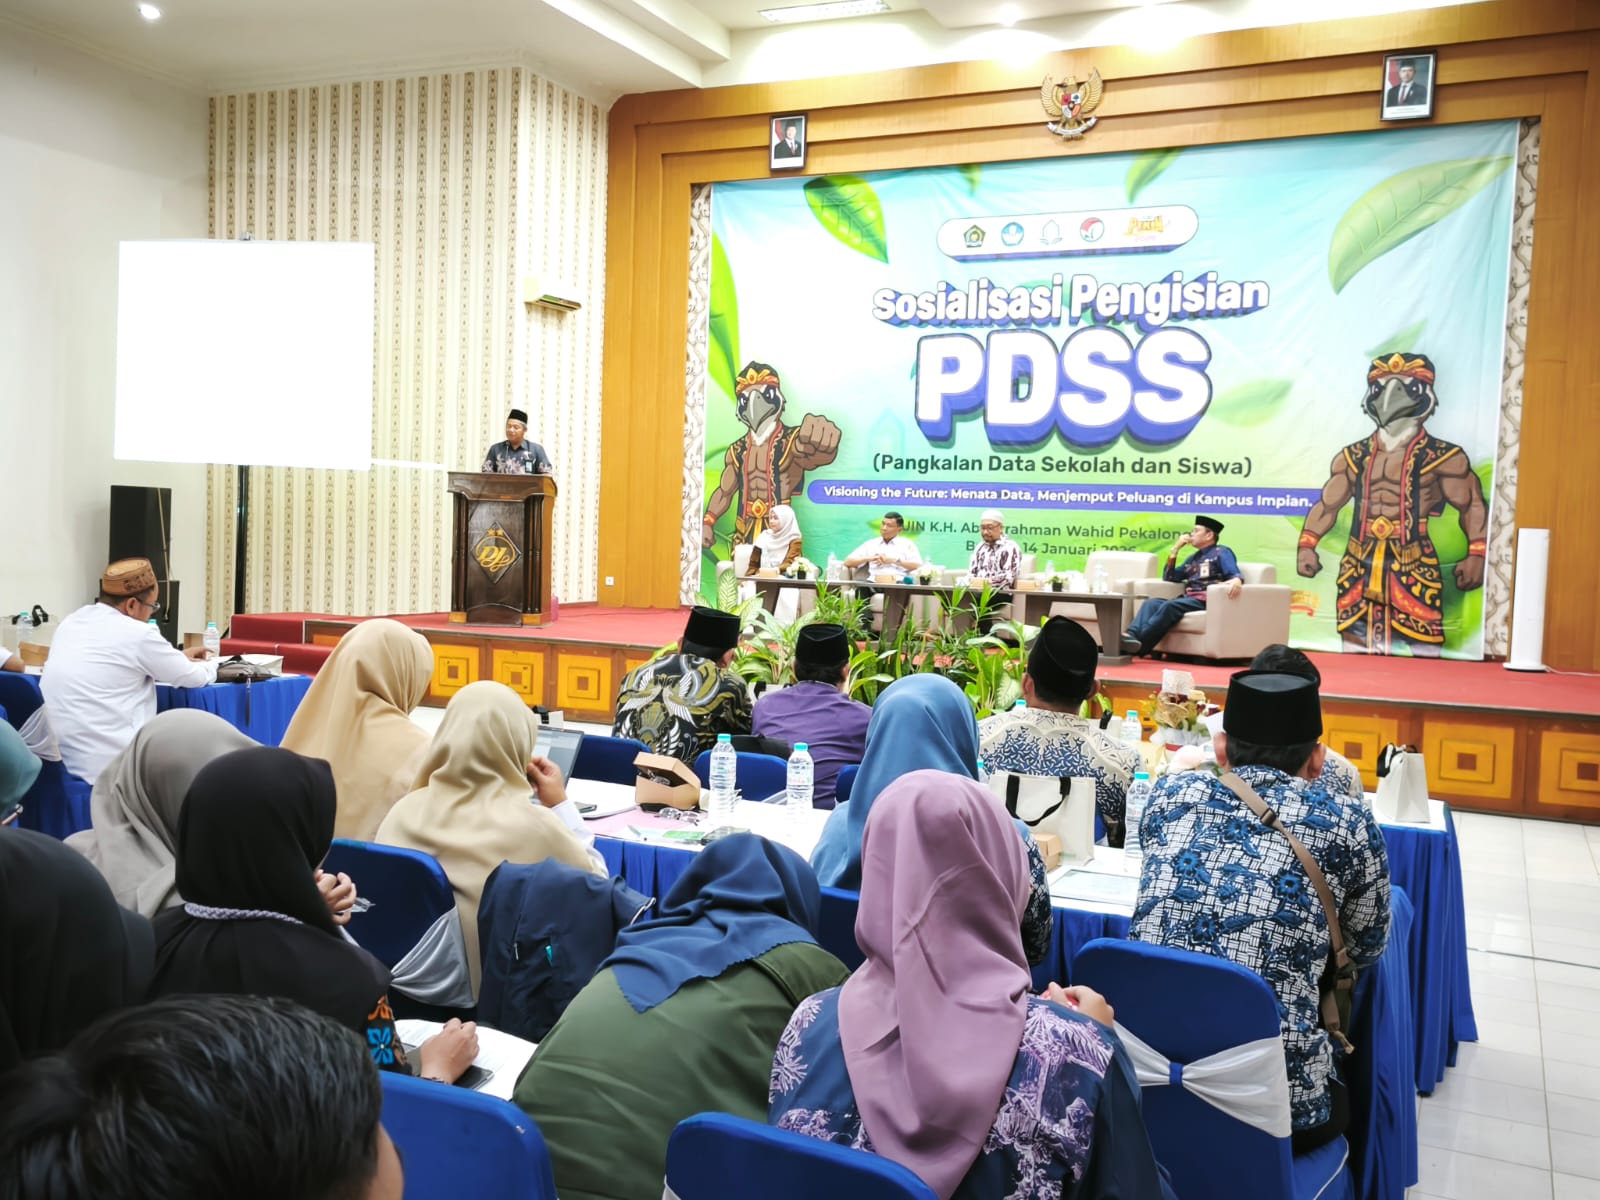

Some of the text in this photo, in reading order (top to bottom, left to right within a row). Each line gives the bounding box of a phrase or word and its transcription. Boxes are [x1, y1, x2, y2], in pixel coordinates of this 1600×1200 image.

[872, 271, 1270, 331] Sosialisasi Pengisian
[915, 327, 1213, 449] PDSS
[873, 453, 1253, 478] (Pangkalan Data Sekolah dan Siswa)
[823, 486, 1313, 508] Visioning the Future: Menata Data, Menjemput Peluang di Kampus Impian.
[930, 521, 957, 533] K.H.
[961, 521, 1061, 537] Abrahman
[1066, 525, 1114, 538] Wahid
[1023, 542, 1037, 553] 14
